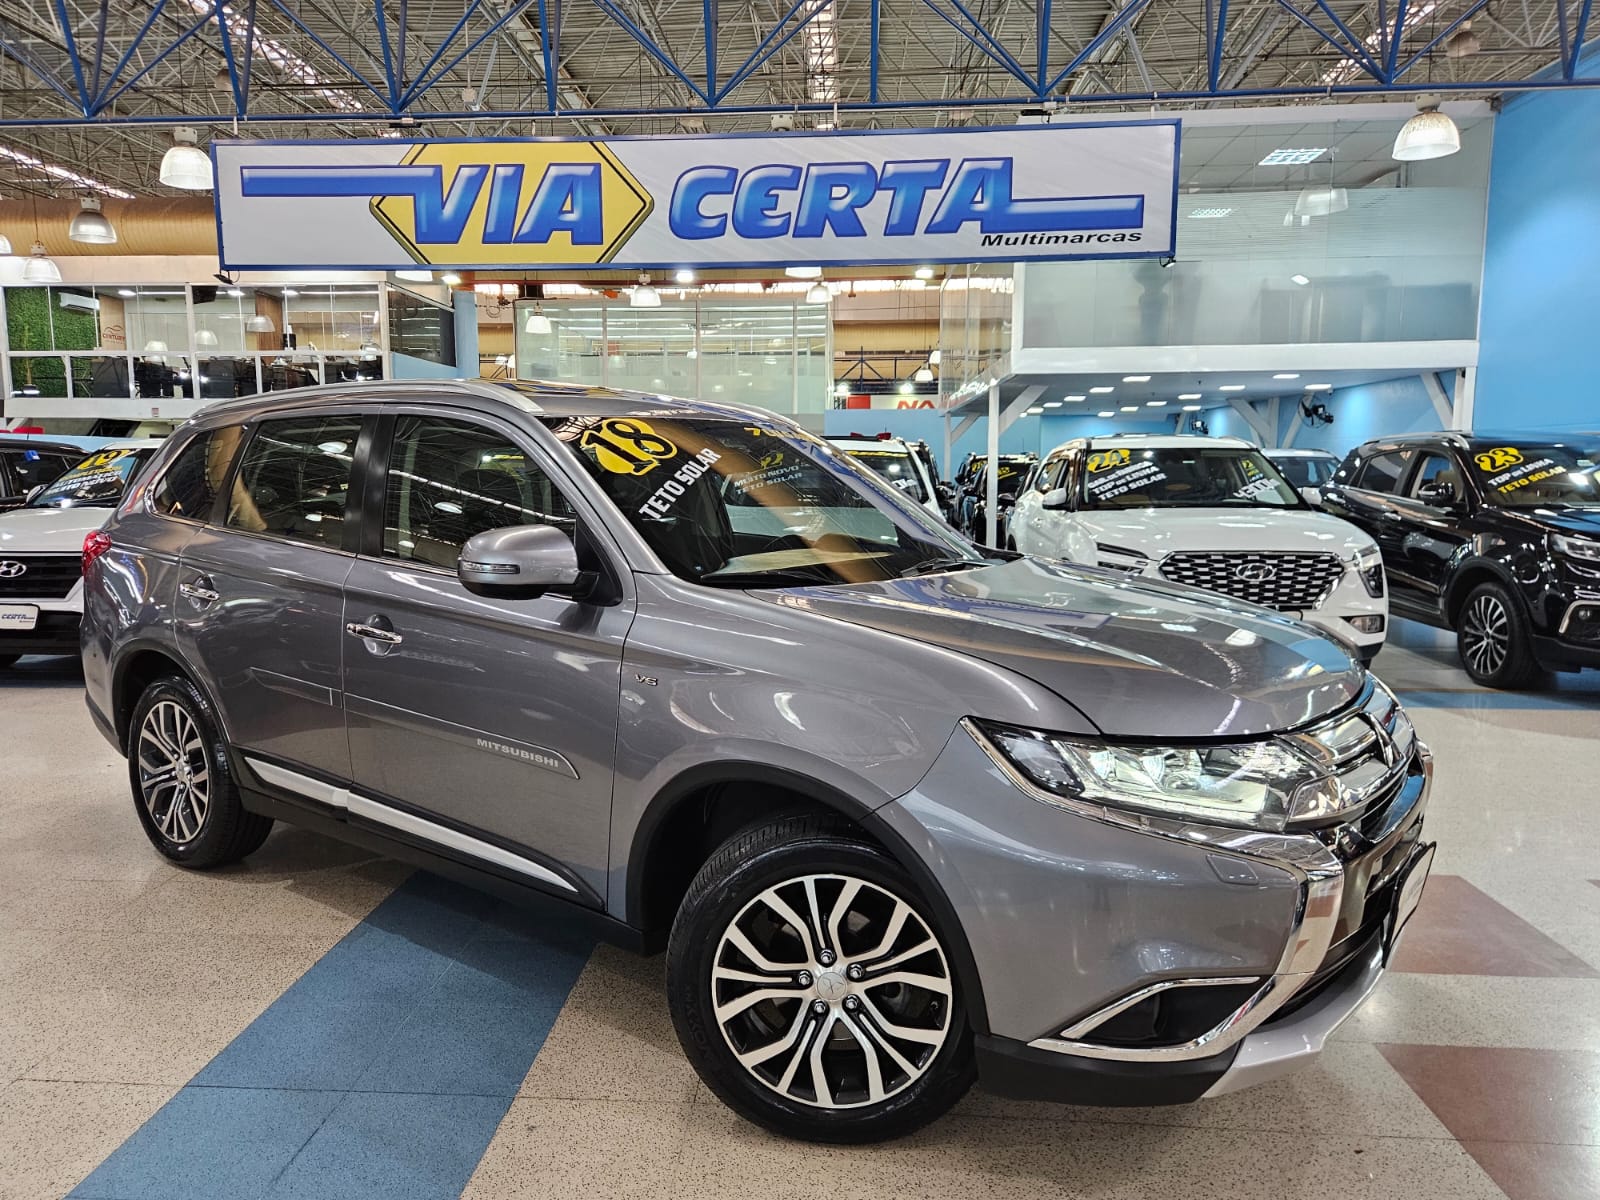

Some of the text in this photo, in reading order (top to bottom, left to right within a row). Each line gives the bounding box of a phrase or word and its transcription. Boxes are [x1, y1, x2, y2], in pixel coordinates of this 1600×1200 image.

[241, 157, 1144, 246] VIA CERTA
[981, 230, 1143, 248] Multimarcas
[582, 418, 677, 475] 18
[1475, 447, 1524, 472] 23
[639, 448, 722, 520] TETO SOLAR
[767, 465, 799, 478] NOVO
[1091, 481, 1115, 494] TOP
[1126, 466, 1160, 481] LINHA
[1487, 472, 1512, 486] TOP
[1520, 458, 1555, 473] LINHA
[1498, 466, 1567, 493] TETO SOLAR
[1098, 473, 1168, 500] TETO SOLAR
[476, 738, 559, 768] MITSUBISHI
